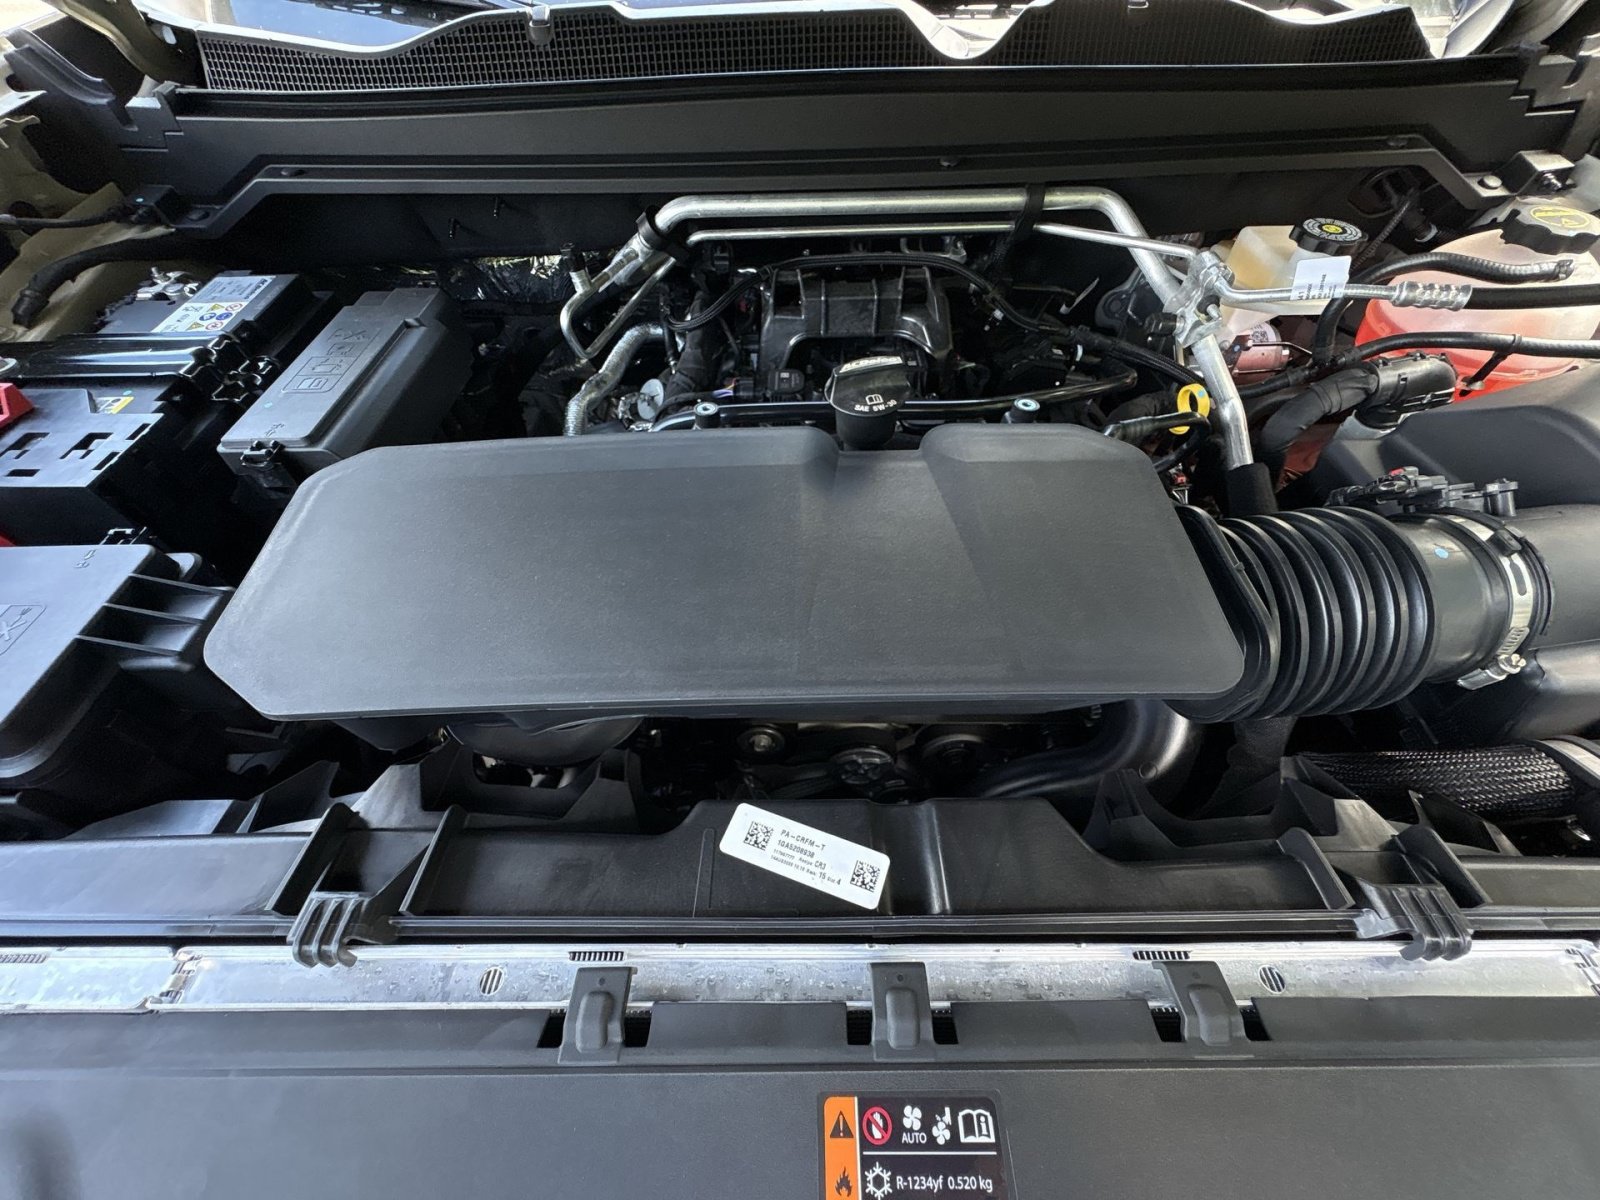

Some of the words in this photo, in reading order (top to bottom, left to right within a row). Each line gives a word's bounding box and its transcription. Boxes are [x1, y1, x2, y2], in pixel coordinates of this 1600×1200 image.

[854, 404, 870, 412] SAE
[819, 871, 827, 880] 15
[901, 1131, 927, 1144] AUTO
[896, 1175, 943, 1194] R-1234yf
[947, 1175, 977, 1190] 0.520
[979, 1175, 993, 1193] kg
